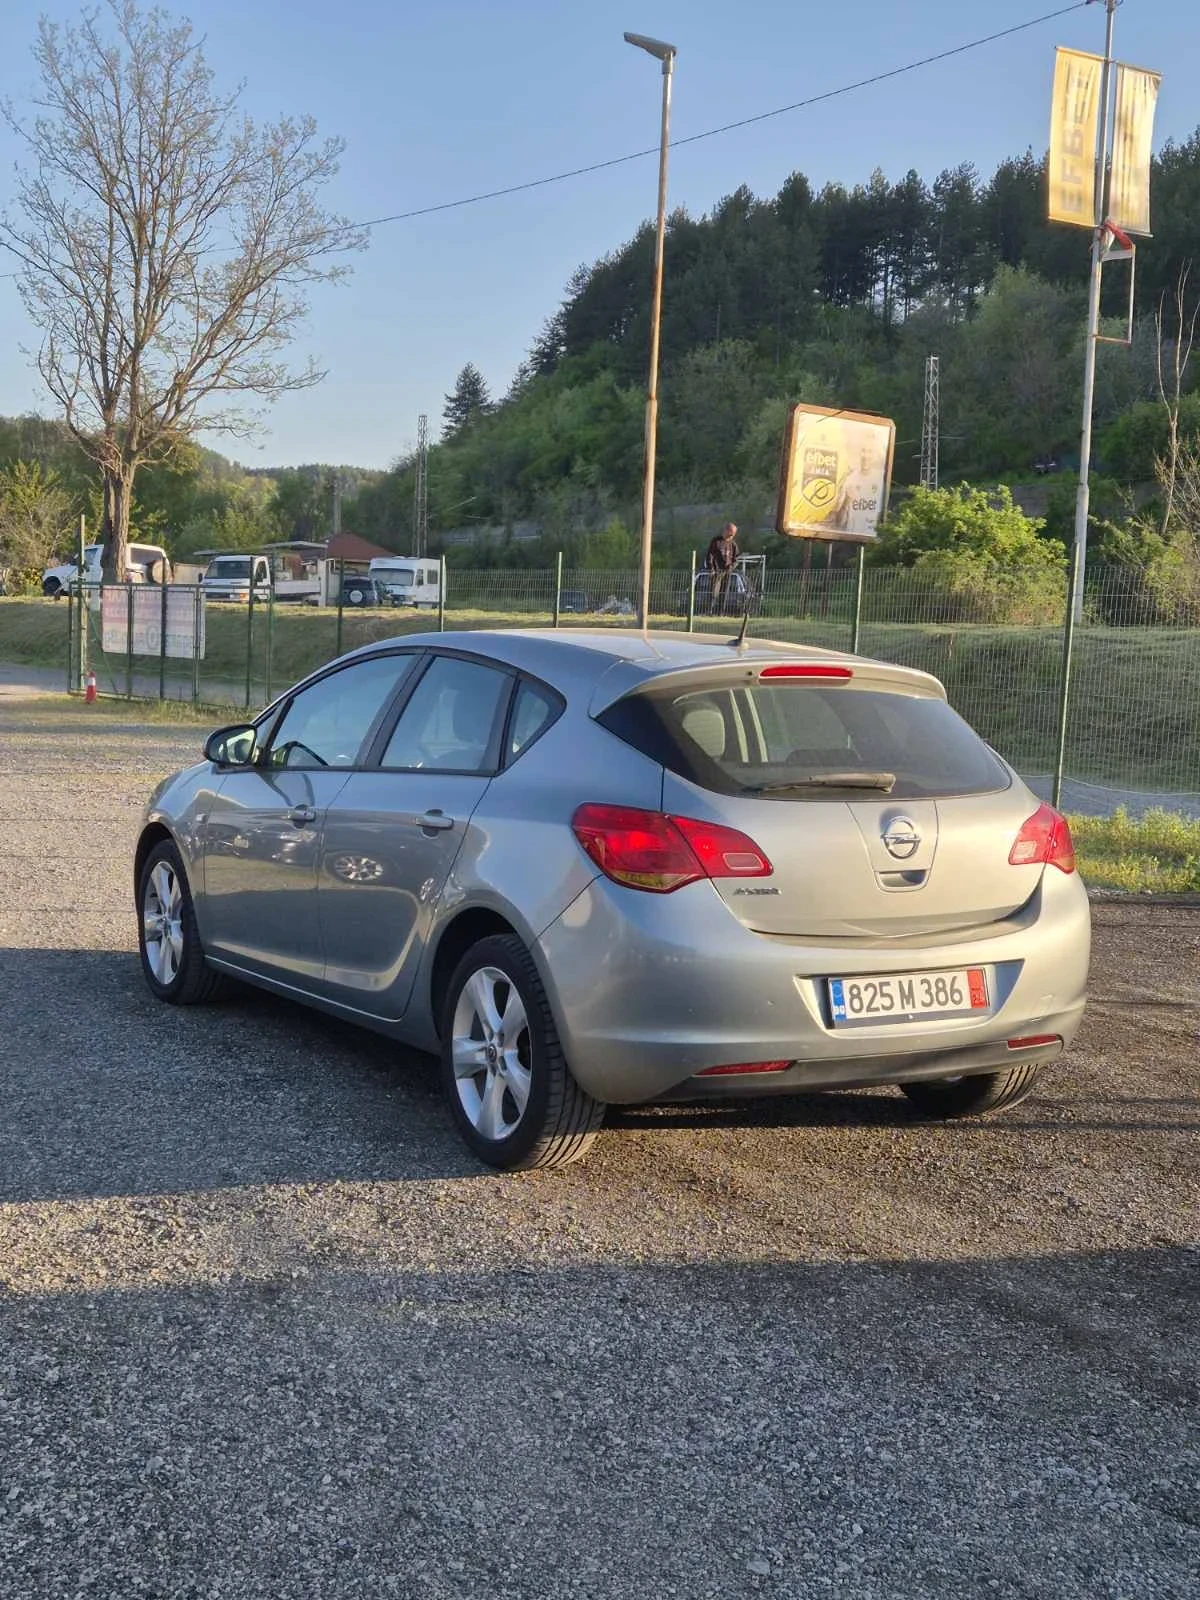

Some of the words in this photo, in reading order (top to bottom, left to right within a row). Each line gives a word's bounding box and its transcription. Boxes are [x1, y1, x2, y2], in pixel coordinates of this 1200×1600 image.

[848, 981, 895, 1014] 825
[898, 979, 916, 1009] M
[920, 975, 963, 1008] 386
